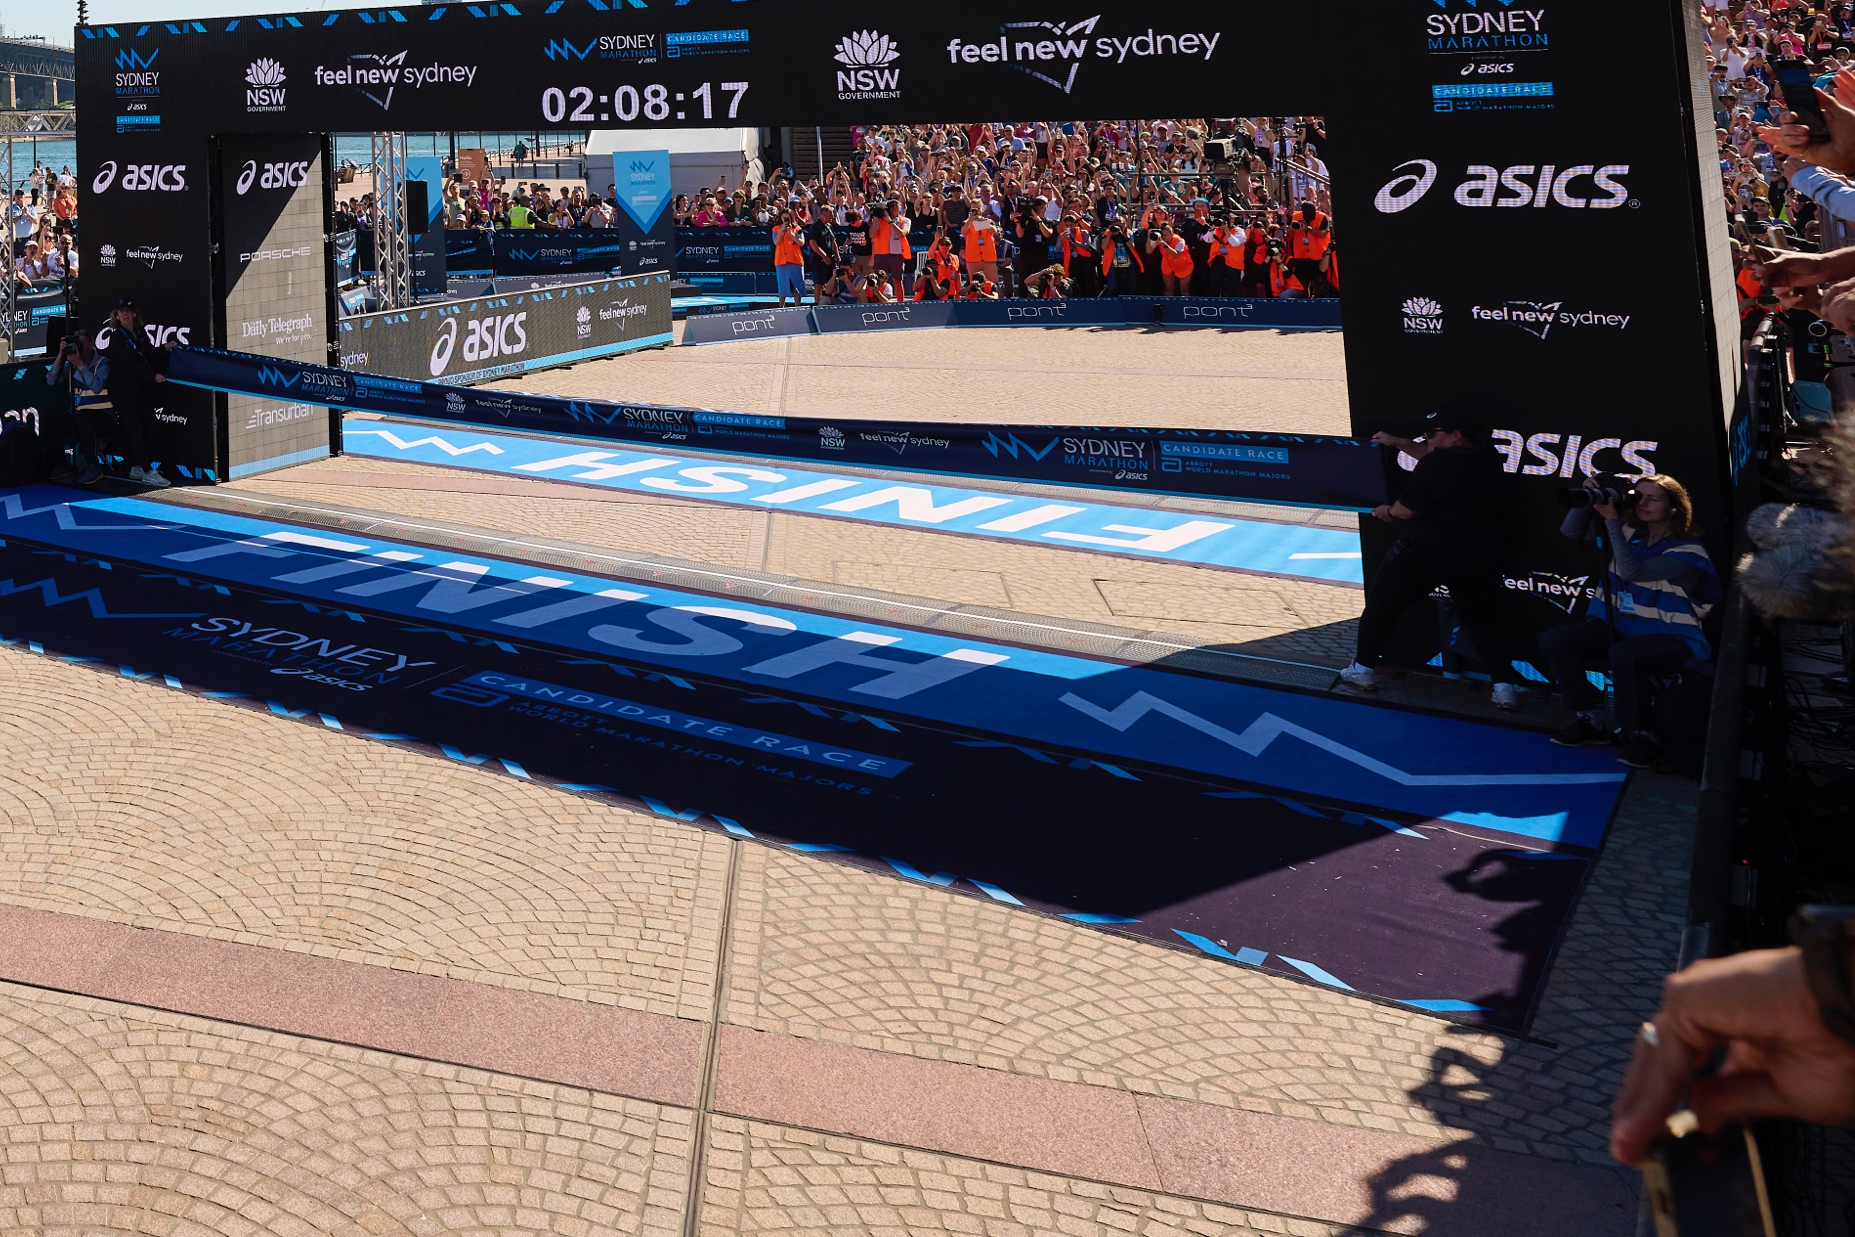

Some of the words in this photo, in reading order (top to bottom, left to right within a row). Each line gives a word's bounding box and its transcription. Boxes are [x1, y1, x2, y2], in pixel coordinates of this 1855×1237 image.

[1427, 10, 1544, 36] SYDNEY
[599, 34, 655, 50] SYDNEY
[668, 32, 719, 42] CANDIDATE
[722, 31, 746, 40] RACE
[1428, 34, 1548, 50] MARATHON
[600, 49, 657, 59] MARATHON
[947, 36, 1008, 63] feel
[1016, 39, 1088, 60] new
[1095, 28, 1220, 64] sydney
[315, 65, 352, 85] feel
[356, 68, 399, 84] new
[404, 62, 477, 88] sydney
[1478, 63, 1514, 74] asics
[116, 72, 159, 86] SYDNEY
[837, 68, 900, 92] NSW
[247, 89, 286, 105] NSW
[838, 90, 901, 100] GOVERNMENT
[1435, 87, 1508, 95] CANDIDATE
[542, 82, 749, 122] 02:08:17
[122, 164, 186, 191] asics
[260, 161, 308, 189] asics
[631, 173, 654, 181] SYDNEY
[1454, 164, 1630, 208] asics
[126, 249, 140, 258] feel
[140, 250, 157, 259] new
[158, 250, 183, 262] sydney
[240, 246, 311, 262] PORSCHE
[599, 308, 612, 320] feel
[612, 308, 626, 318] new
[626, 304, 646, 318] sydney
[1472, 306, 1508, 320] feel
[1512, 310, 1555, 322] new
[1559, 310, 1630, 329] sydney
[242, 320, 268, 337] Daily
[268, 313, 312, 334] Telegraph
[578, 324, 591, 335] NSW
[1404, 318, 1443, 330] NSW
[144, 325, 190, 347] SICS
[464, 312, 526, 362] asics
[340, 352, 368, 368] sydney
[302, 372, 346, 388] SYDNEY
[455, 370, 476, 382] SPONSOR
[476, 371, 482, 380] OF
[483, 367, 501, 378] SYDNEY
[502, 362, 524, 374] MARATHON
[301, 384, 348, 396] MARATHON
[356, 378, 396, 388] CANDIDATE
[446, 402, 466, 412] NSW
[476, 398, 492, 407] feel
[512, 404, 542, 414] sydney
[162, 414, 187, 426] sydney
[255, 404, 314, 426] Transurban
[624, 408, 684, 424] SYDNEY
[695, 414, 752, 426] CANDIDATE
[755, 418, 782, 428] RACE
[627, 420, 688, 432] MARATHON
[820, 437, 846, 448] NSW
[860, 433, 882, 442] feel
[884, 435, 908, 444] new
[910, 436, 950, 449] sydney
[1064, 438, 1145, 458] SYDNEY
[1164, 444, 1242, 457] CANDIDATE
[1248, 450, 1284, 460] RACE
[1064, 455, 1148, 470] MARATHON
[1125, 472, 1148, 481] asics
[1212, 468, 1256, 477] MARATHON
[510, 449, 1236, 556] FINISH
[1502, 574, 1534, 592] eel
[1537, 581, 1581, 596] new
[162, 531, 1012, 701] FINISH
[191, 617, 437, 673] SYDNEY
[162, 627, 401, 686] MARATHON
[302, 673, 374, 692] asics
[516, 702, 611, 724] ABBOTT
[480, 676, 733, 737] CANDIDATE
[752, 735, 887, 770] RACE
[508, 705, 589, 729] WORLD
[594, 727, 746, 767] MARATHON
[755, 764, 874, 796] MAJORS
